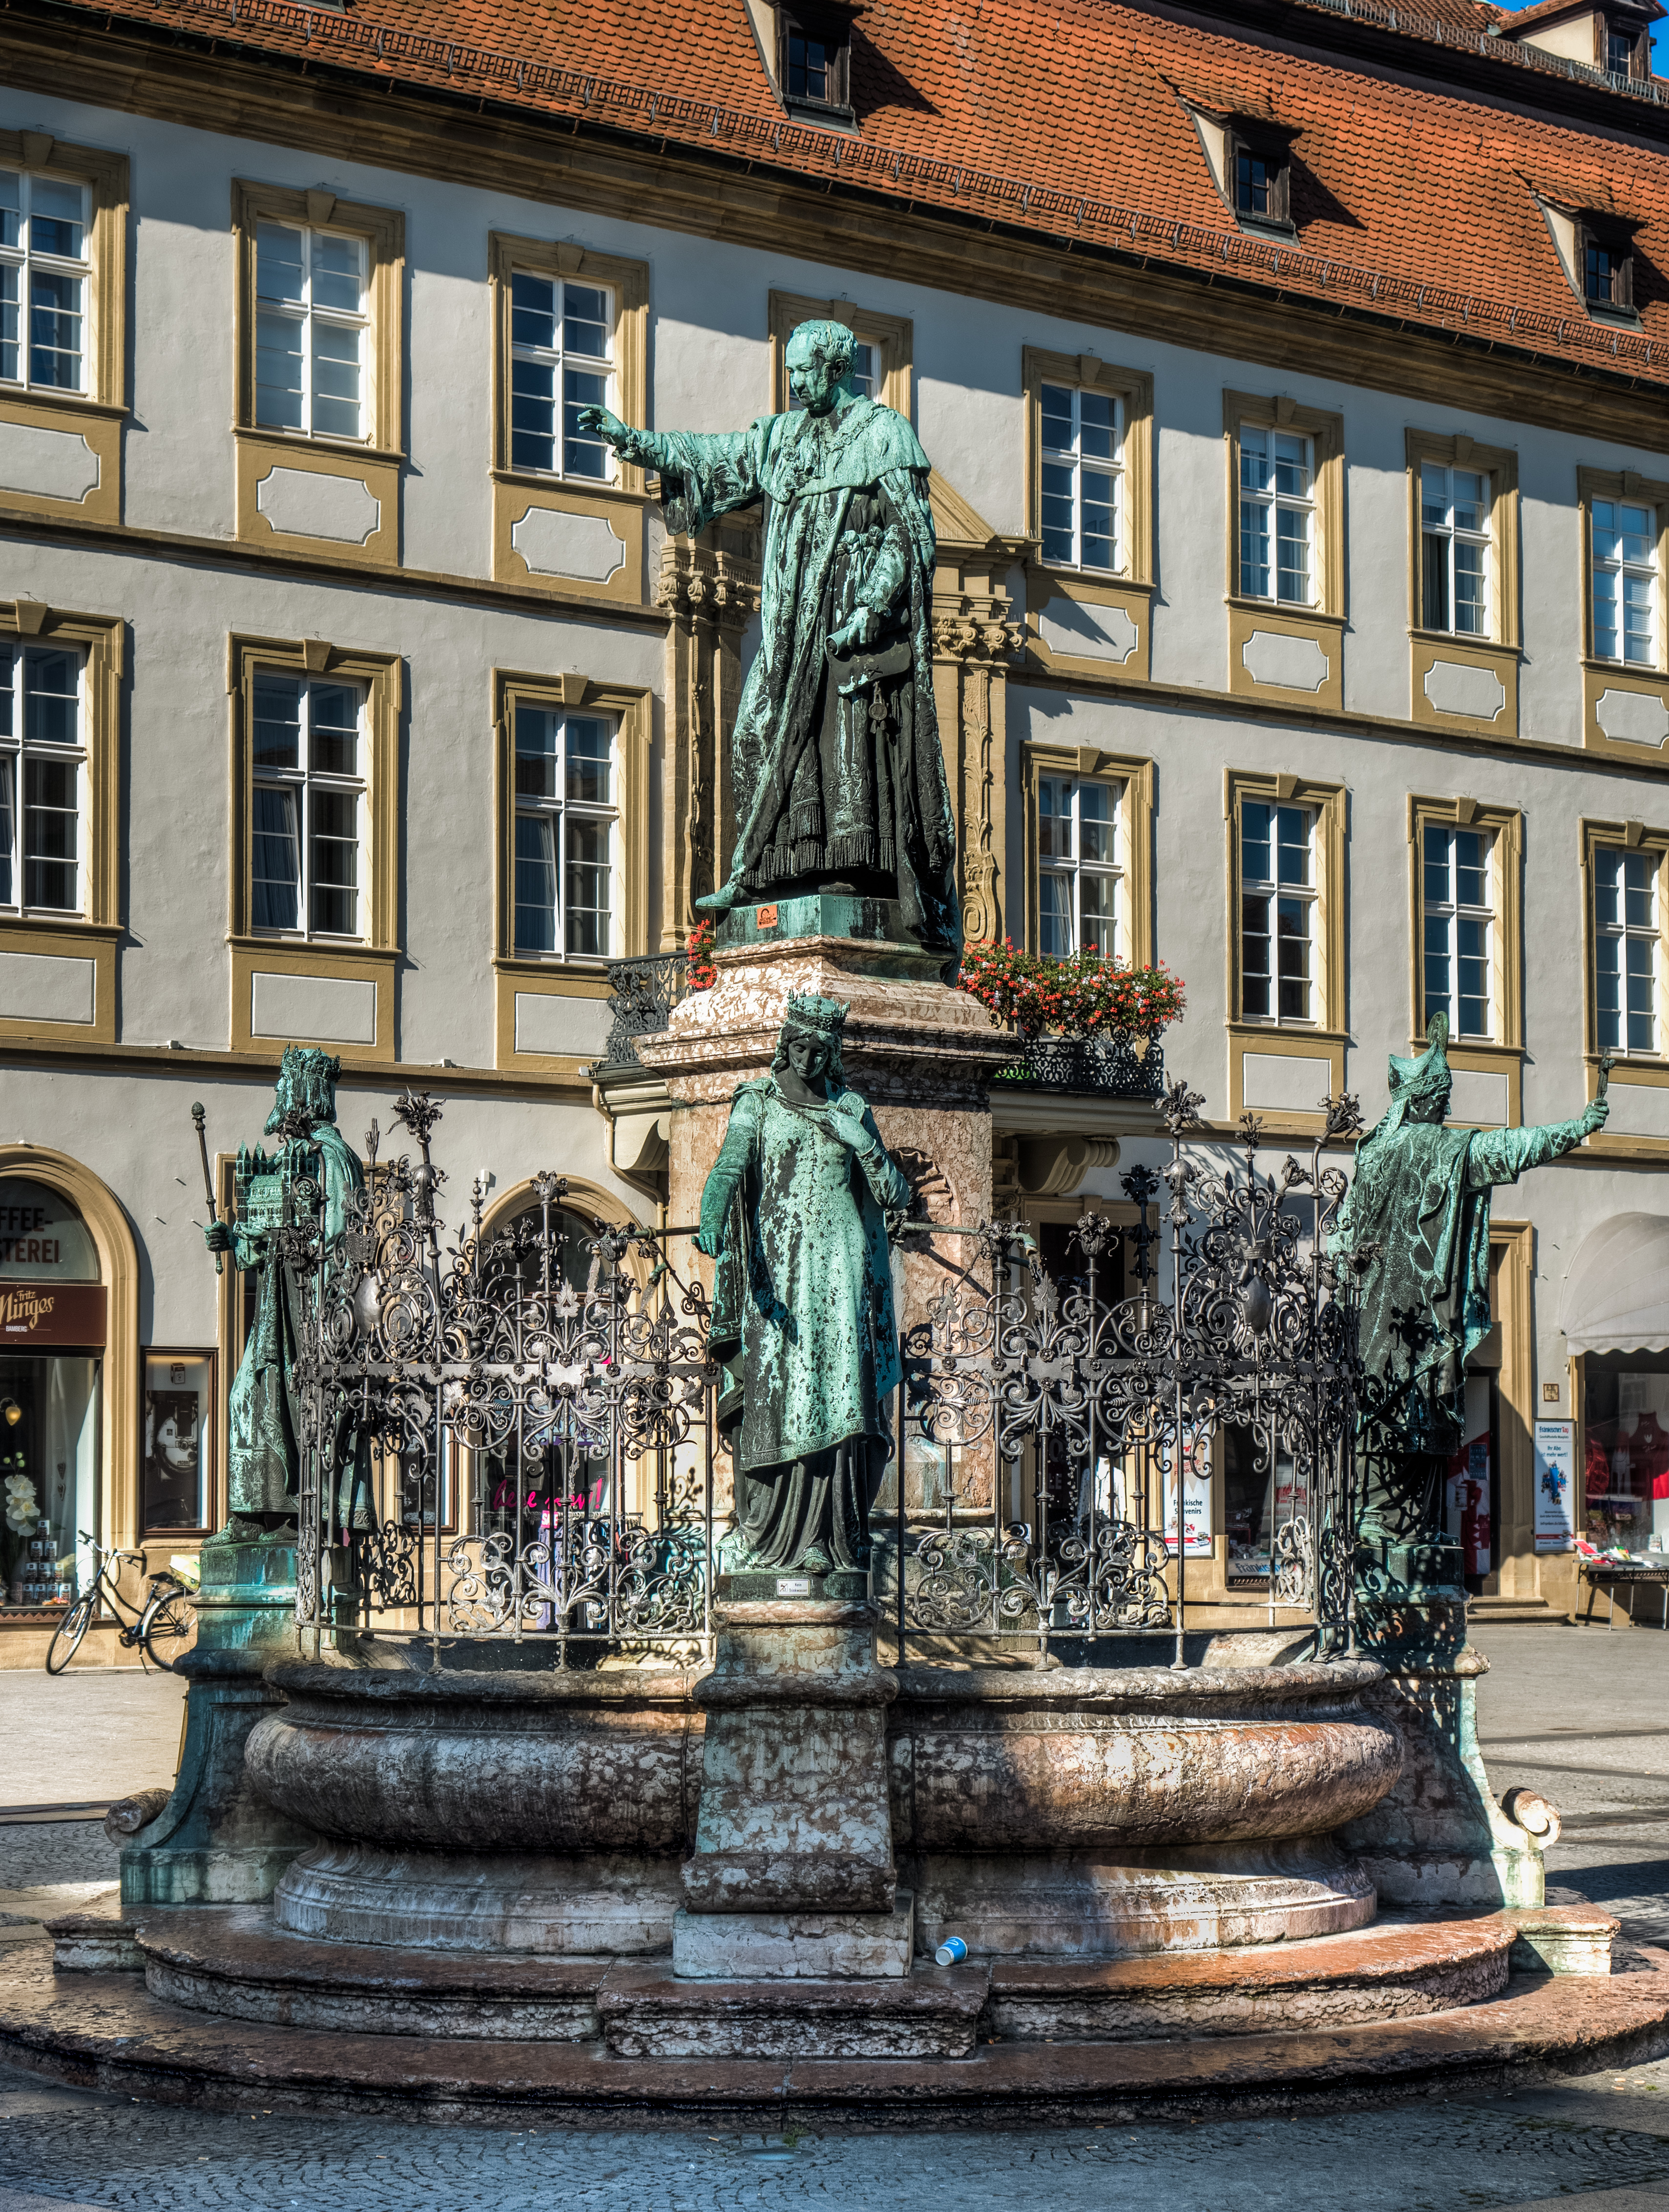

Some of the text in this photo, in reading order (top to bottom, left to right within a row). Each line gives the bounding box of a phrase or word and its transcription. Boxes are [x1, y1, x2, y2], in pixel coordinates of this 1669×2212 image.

[0, 1238, 59, 1263] TEREI
[17, 1291, 36, 1301] Fritz
[542, 1513, 559, 1525] SAE
